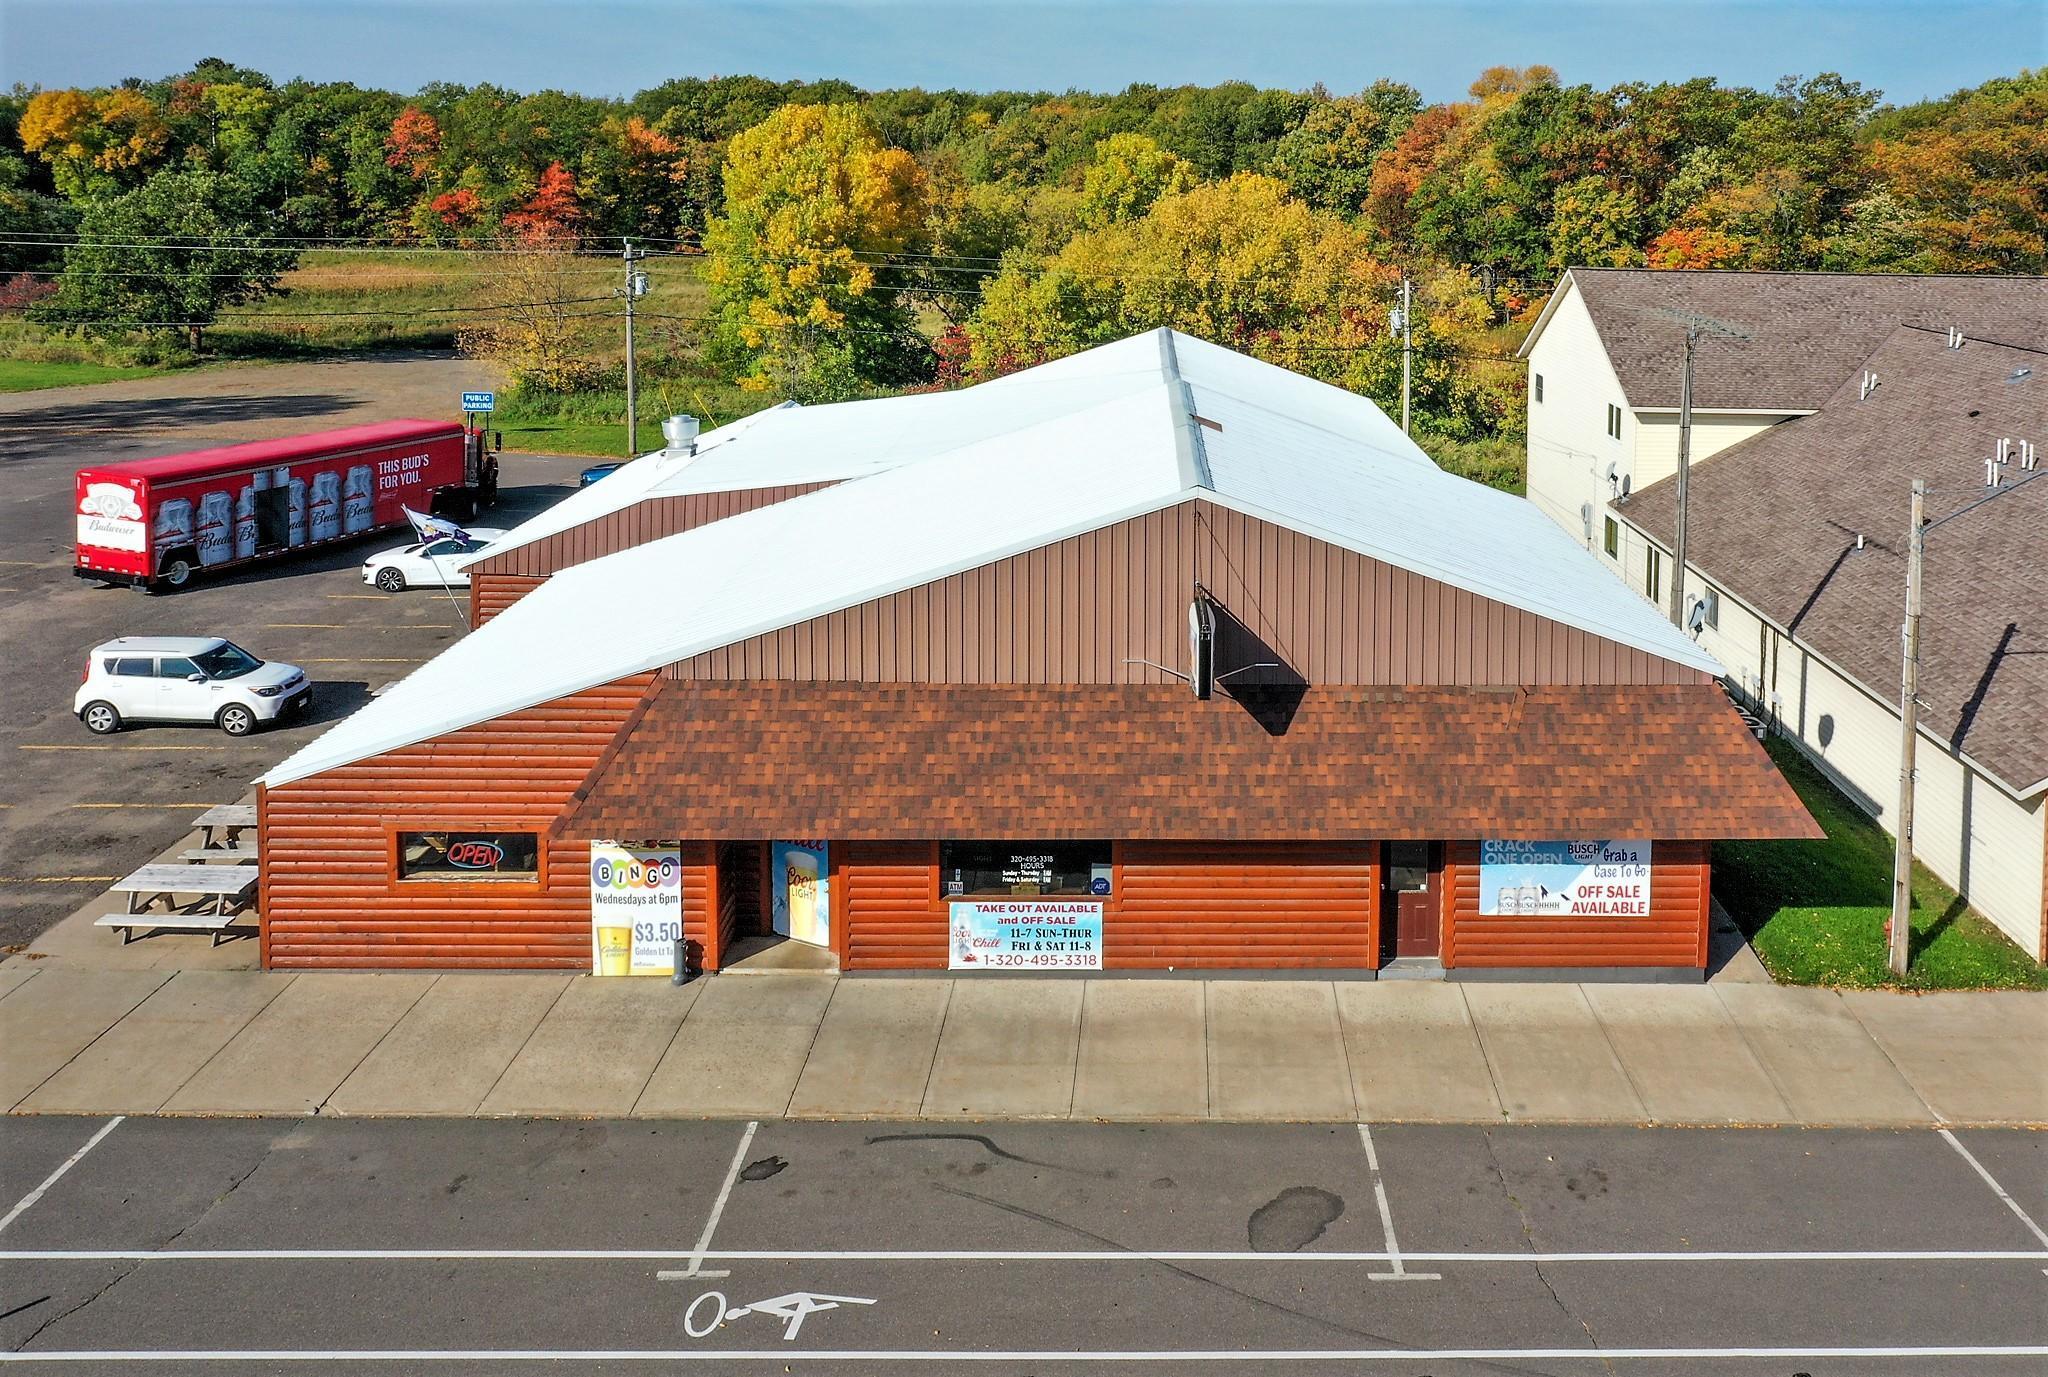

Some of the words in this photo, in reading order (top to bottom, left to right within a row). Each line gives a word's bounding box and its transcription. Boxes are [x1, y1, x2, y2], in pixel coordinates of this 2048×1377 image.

[378, 459, 400, 475] THIS
[402, 453, 429, 470] BUD'S
[379, 475, 398, 489] FOR
[400, 470, 422, 486] YOU.
[89, 519, 136, 535] Budweiser
[1484, 840, 1536, 852] CRACK
[1567, 844, 1600, 855] BUSCH
[449, 842, 499, 867] OPEN
[1010, 855, 1054, 863] 320-495-3318
[1484, 852, 1518, 865] ONE
[1520, 852, 1563, 865] OPEN
[1603, 848, 1628, 862] Grab
[1630, 851, 1638, 862] a
[1020, 862, 1045, 870] HOURS
[1594, 864, 1617, 878] Case
[1620, 863, 1632, 878] To
[601, 863, 671, 884] BINGO
[1002, 869, 1018, 877] Sunday
[791, 887, 813, 901] LIGHT
[1577, 885, 1603, 898] OFF
[1606, 885, 1641, 898] SALE
[595, 892, 647, 906] Wednesdays
[648, 894, 657, 905] at
[659, 892, 678, 907] 6pm
[976, 904, 1006, 913] TAKE
[1008, 904, 1031, 913] OUT
[1034, 904, 1098, 913] AVAILABLE
[1570, 901, 1646, 914] AVAILABLE
[997, 916, 1018, 925] and
[1021, 916, 1044, 925] OFF
[1046, 916, 1076, 925] SALE
[635, 921, 680, 944] $3.50
[1010, 928, 1032, 938] 11-7
[1035, 928, 1092, 938] SUN-THUR
[972, 937, 1001, 948] Chill
[1011, 941, 1030, 951] FRI
[1034, 941, 1043, 951] &
[1046, 941, 1065, 951] SAT
[1069, 941, 1092, 951] 11-8
[634, 947, 658, 956] Golden
[658, 947, 665, 956] Lt
[984, 954, 1097, 966] 1-320-495-3318
